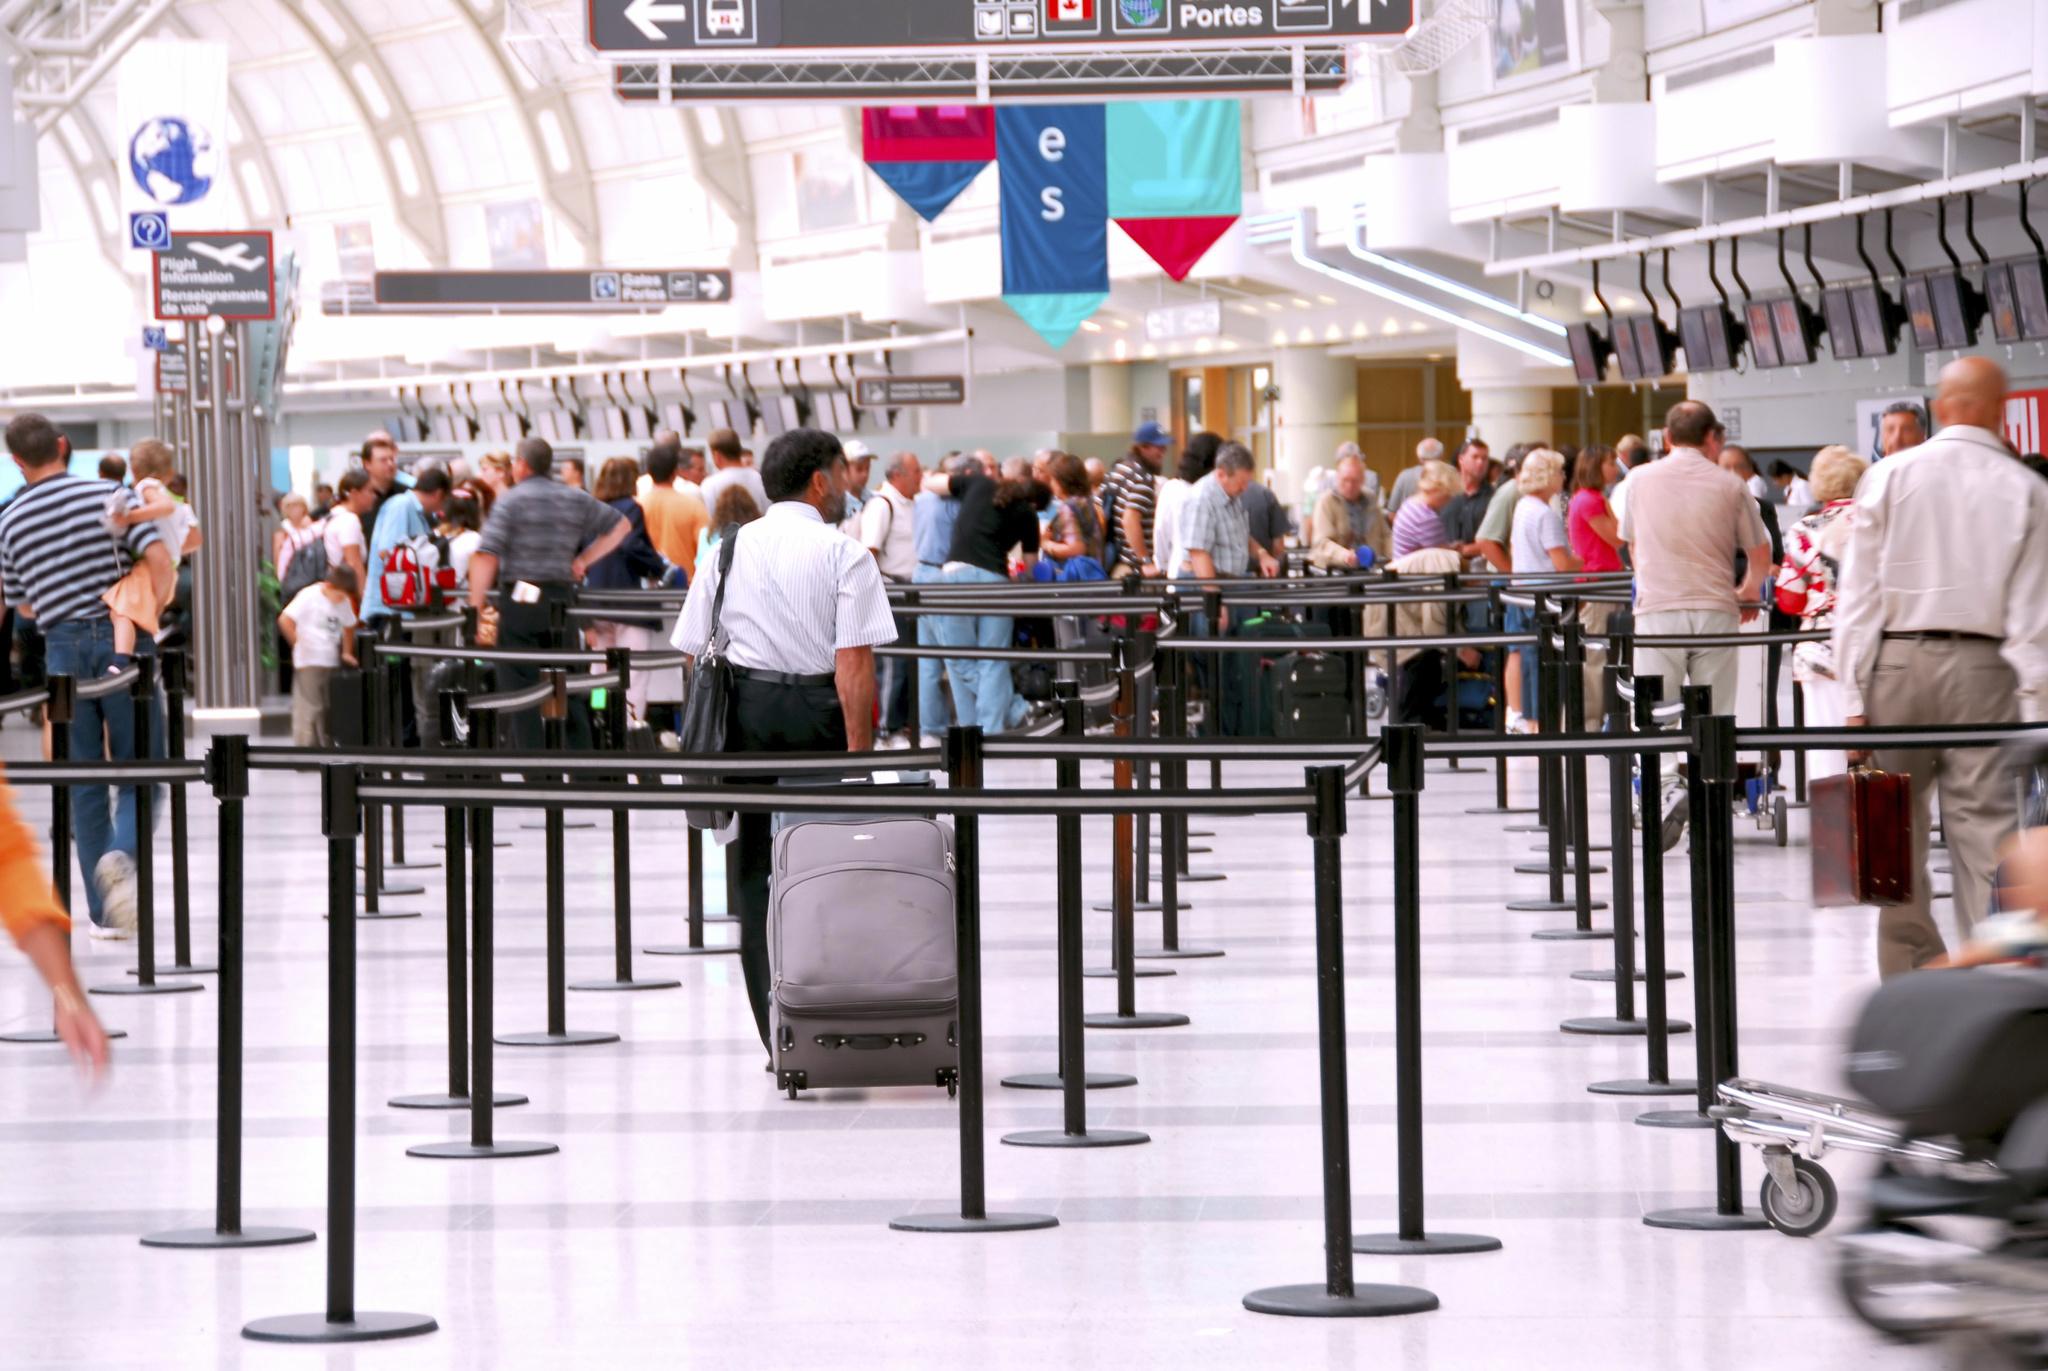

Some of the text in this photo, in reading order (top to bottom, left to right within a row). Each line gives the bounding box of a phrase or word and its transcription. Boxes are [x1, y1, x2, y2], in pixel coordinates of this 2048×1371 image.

[1180, 4, 1263, 28] Portes
[160, 257, 198, 272] Flight
[162, 289, 268, 304] Renseignements
[162, 302, 209, 315] de vols
